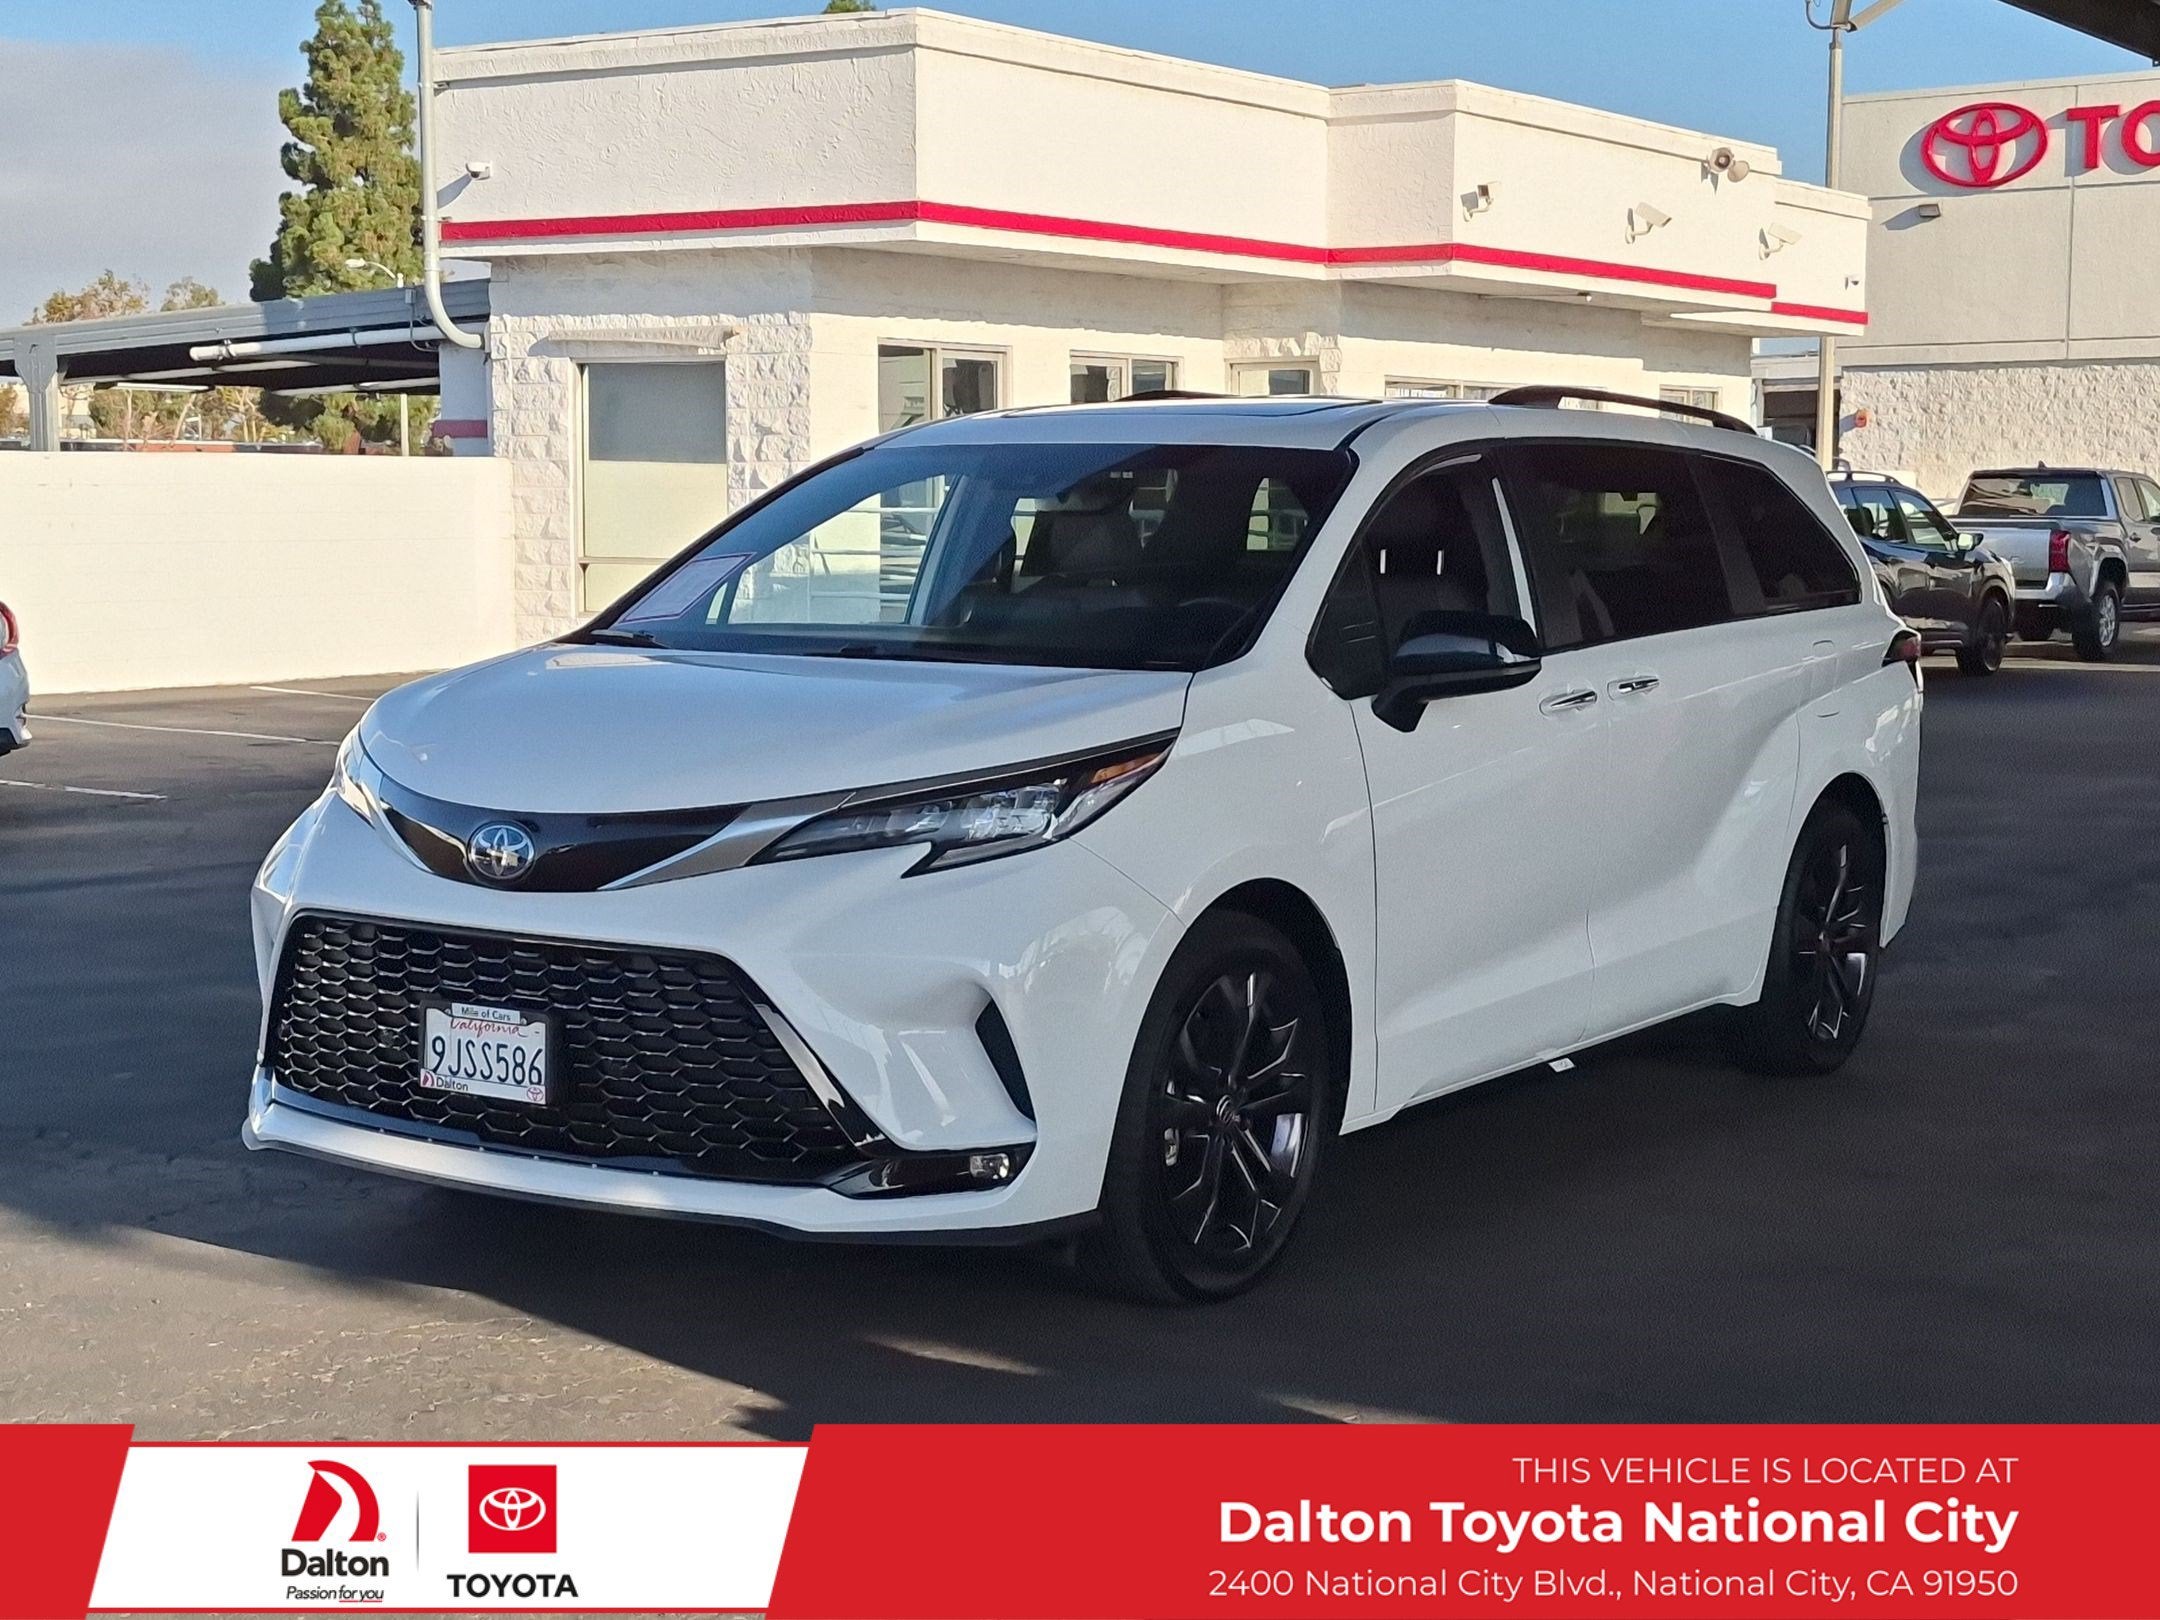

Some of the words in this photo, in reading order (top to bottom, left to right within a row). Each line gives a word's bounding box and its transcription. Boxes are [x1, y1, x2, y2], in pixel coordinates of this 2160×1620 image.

[461, 1006, 479, 1017] Mile
[481, 1009, 490, 1018] of
[491, 1011, 511, 1022] Cars
[431, 1035, 544, 1086] 9JSS586
[436, 1077, 469, 1092] Dalton
